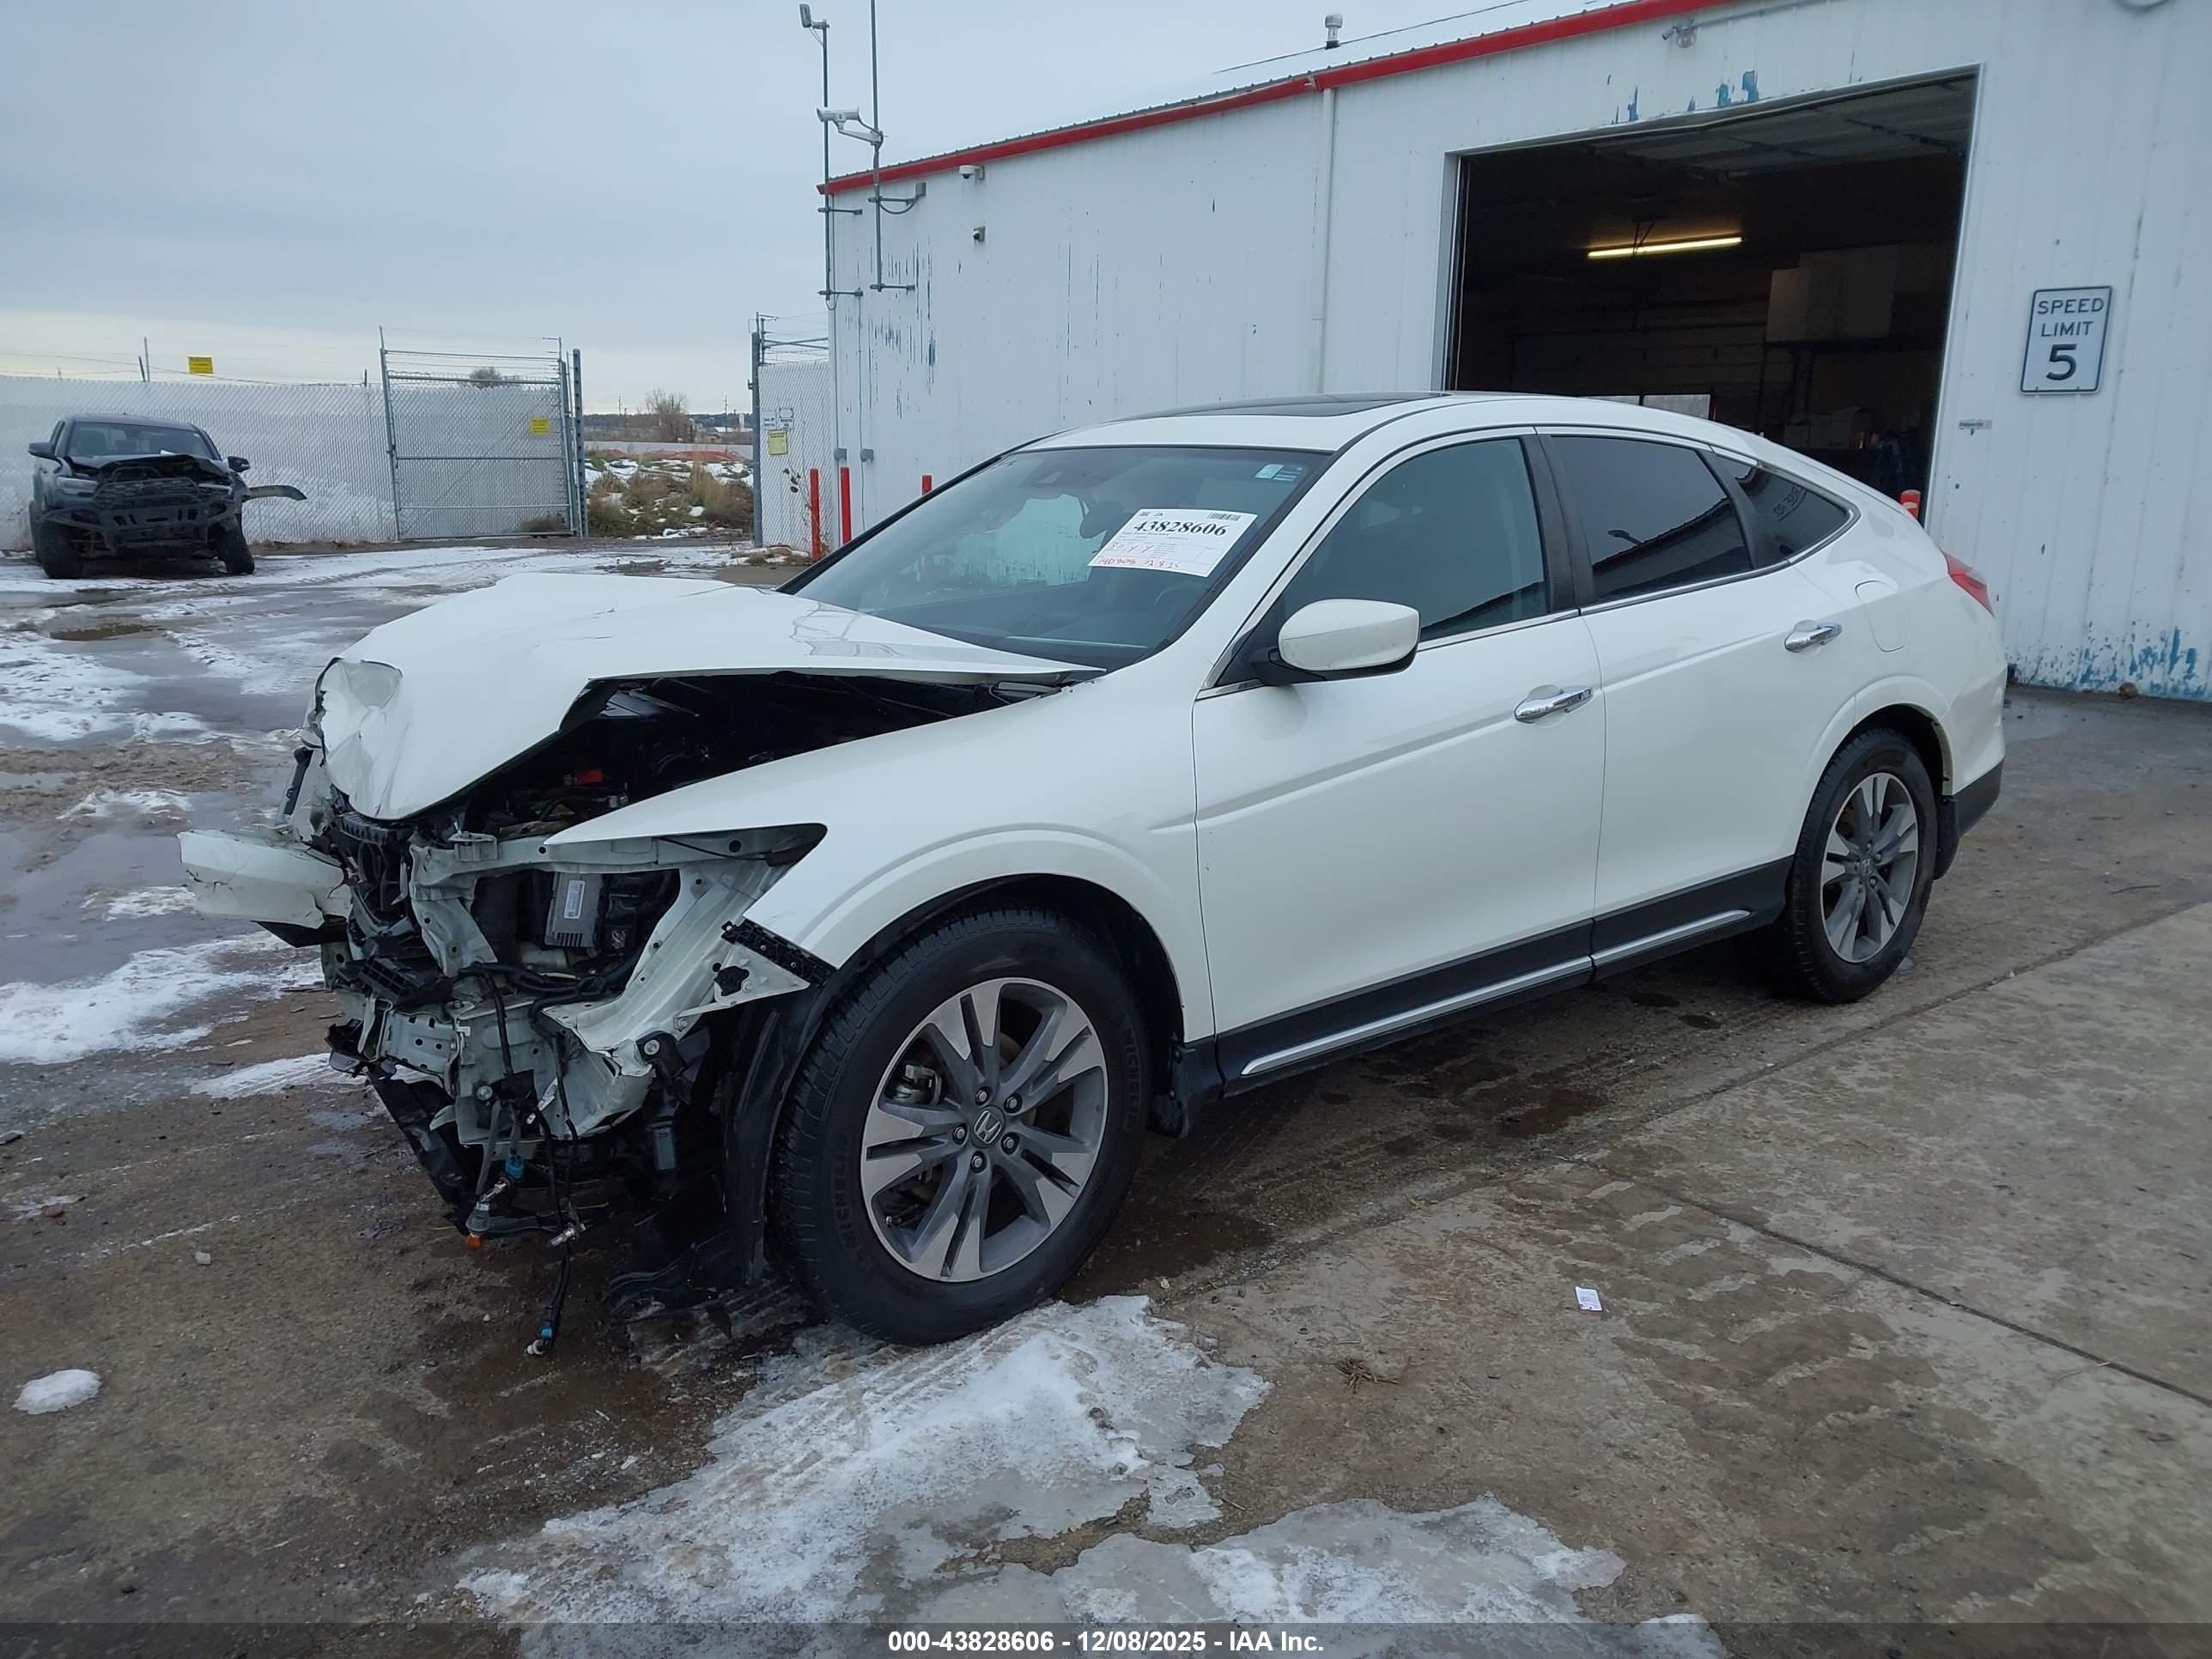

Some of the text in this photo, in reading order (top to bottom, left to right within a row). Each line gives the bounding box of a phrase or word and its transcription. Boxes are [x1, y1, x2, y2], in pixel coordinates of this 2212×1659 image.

[2037, 297, 2105, 315] SPEED
[2040, 320, 2094, 337] LIMIT
[2045, 343, 2078, 381] 5
[1133, 520, 1230, 537] 43828606
